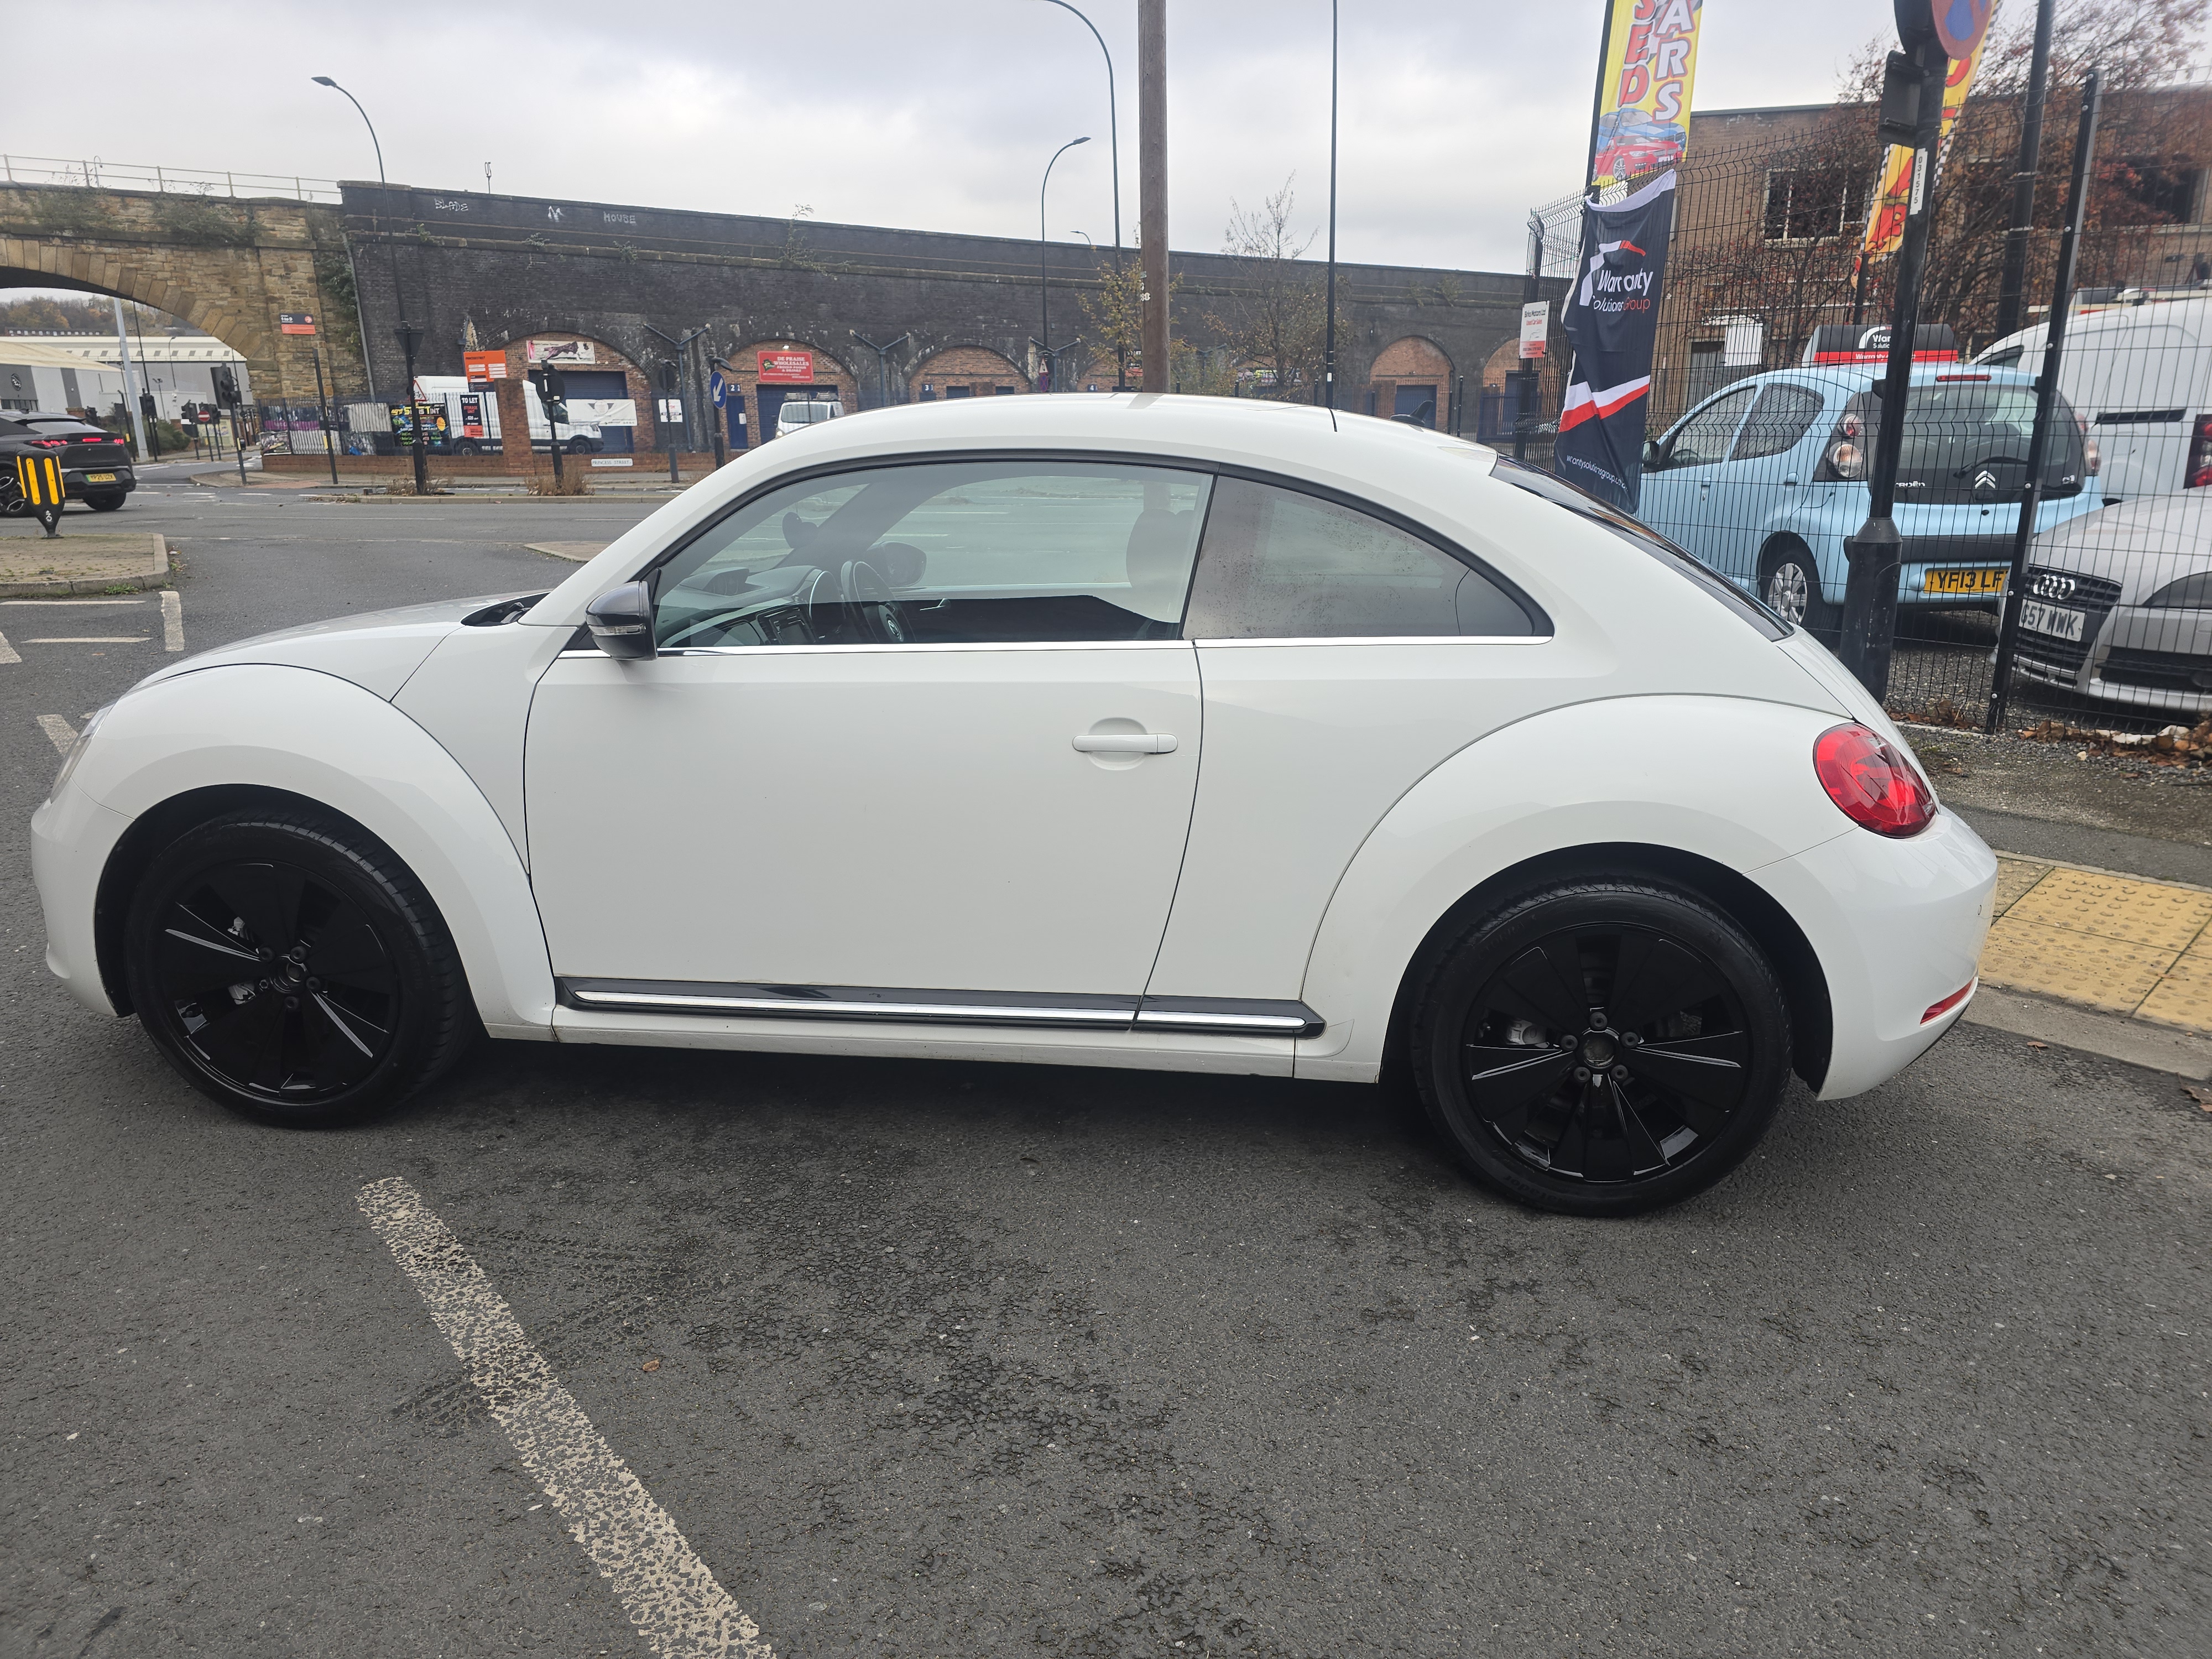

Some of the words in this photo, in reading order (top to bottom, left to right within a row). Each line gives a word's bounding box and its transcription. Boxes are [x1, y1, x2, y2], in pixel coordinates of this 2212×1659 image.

[1914, 156, 1923, 204] 031575
[1938, 571, 1976, 588] YF13
[1980, 571, 2008, 588] LF
